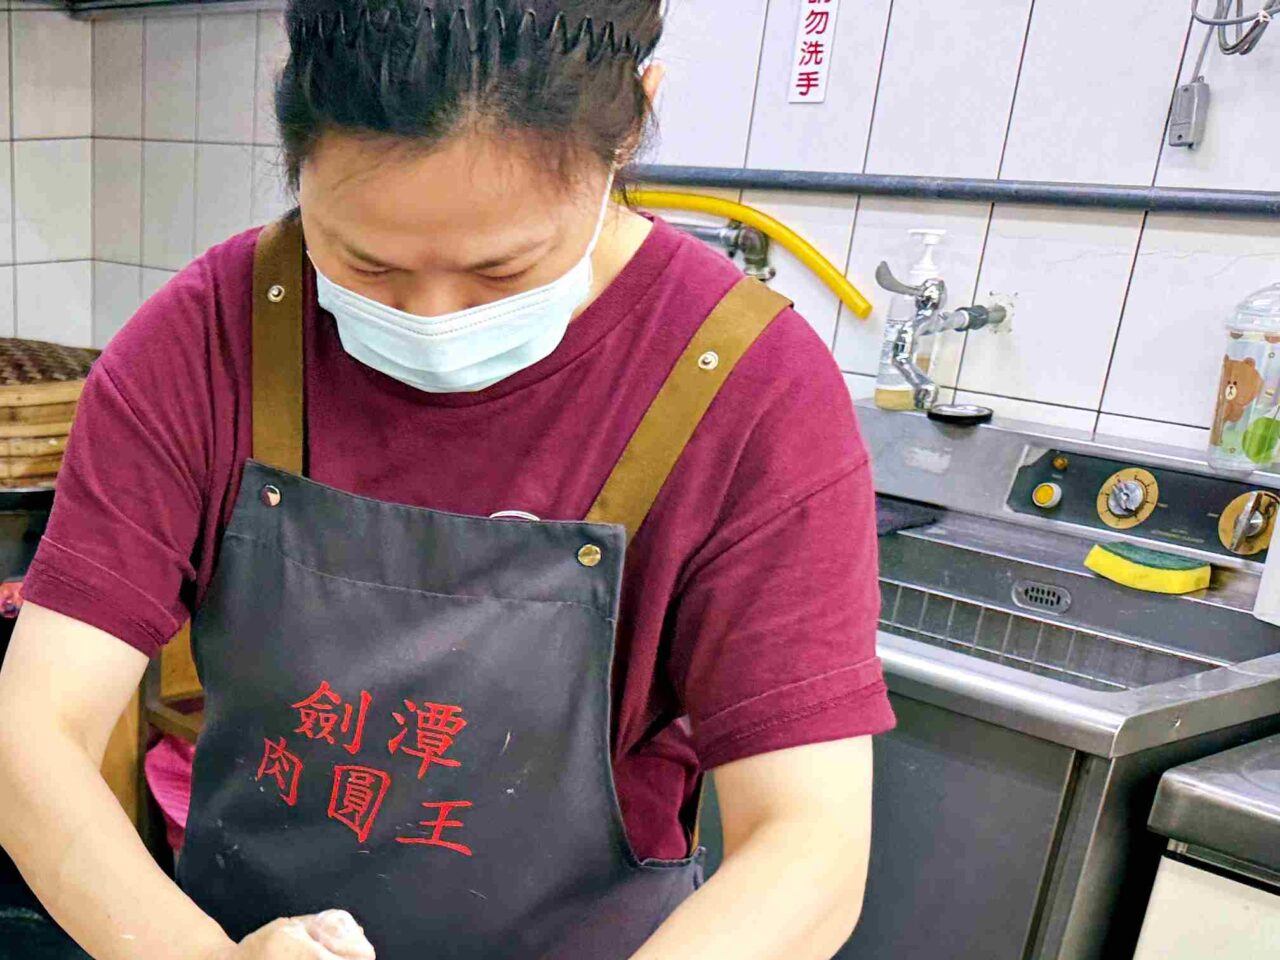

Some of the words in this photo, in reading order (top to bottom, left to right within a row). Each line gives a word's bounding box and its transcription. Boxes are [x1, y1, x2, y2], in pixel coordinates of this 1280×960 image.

[796, 0, 832, 96] 勿洗手
[291, 680, 468, 780] 劍潭
[255, 736, 473, 856] 肉圓王
